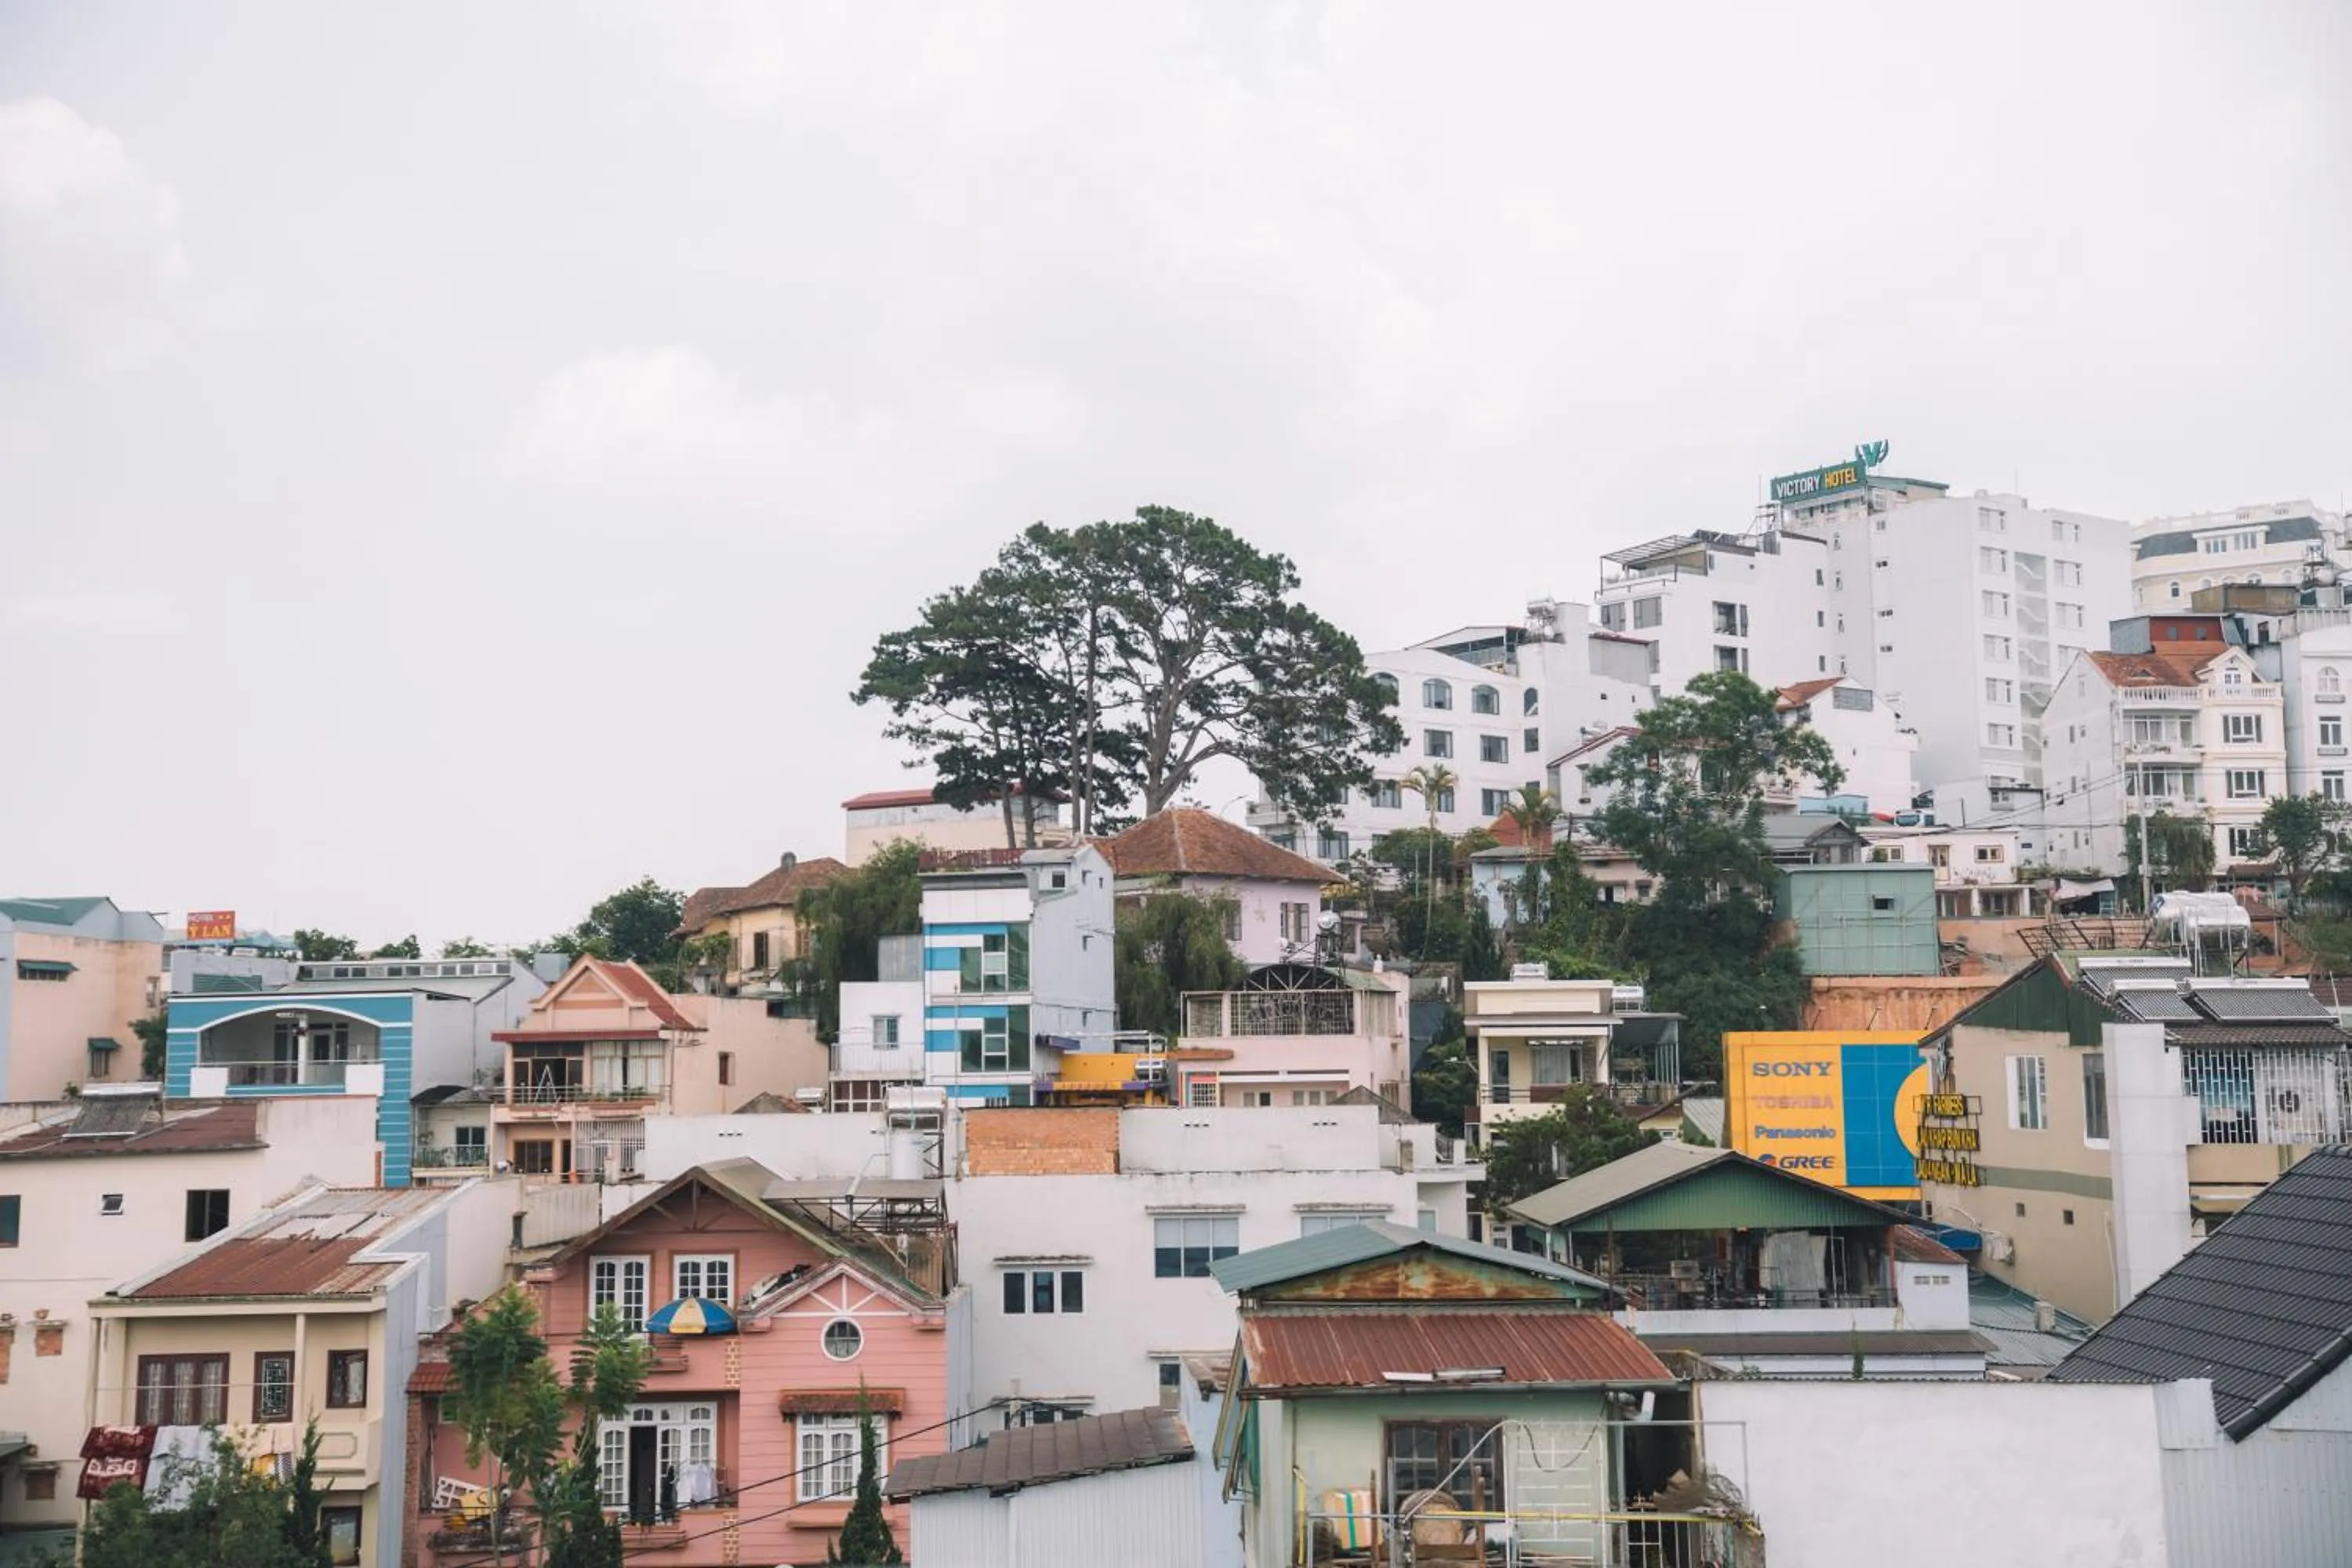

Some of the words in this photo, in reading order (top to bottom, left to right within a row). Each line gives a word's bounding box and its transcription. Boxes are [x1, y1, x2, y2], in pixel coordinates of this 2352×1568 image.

[1777, 474, 1820, 498] VICTORY
[1824, 467, 1857, 488] HOTEL
[1752, 1062, 1832, 1076] SONY
[1755, 1095, 1835, 1109] TOSHIBA
[1755, 1124, 1836, 1139] Panasonic
[1780, 1155, 1836, 1169] GREE
